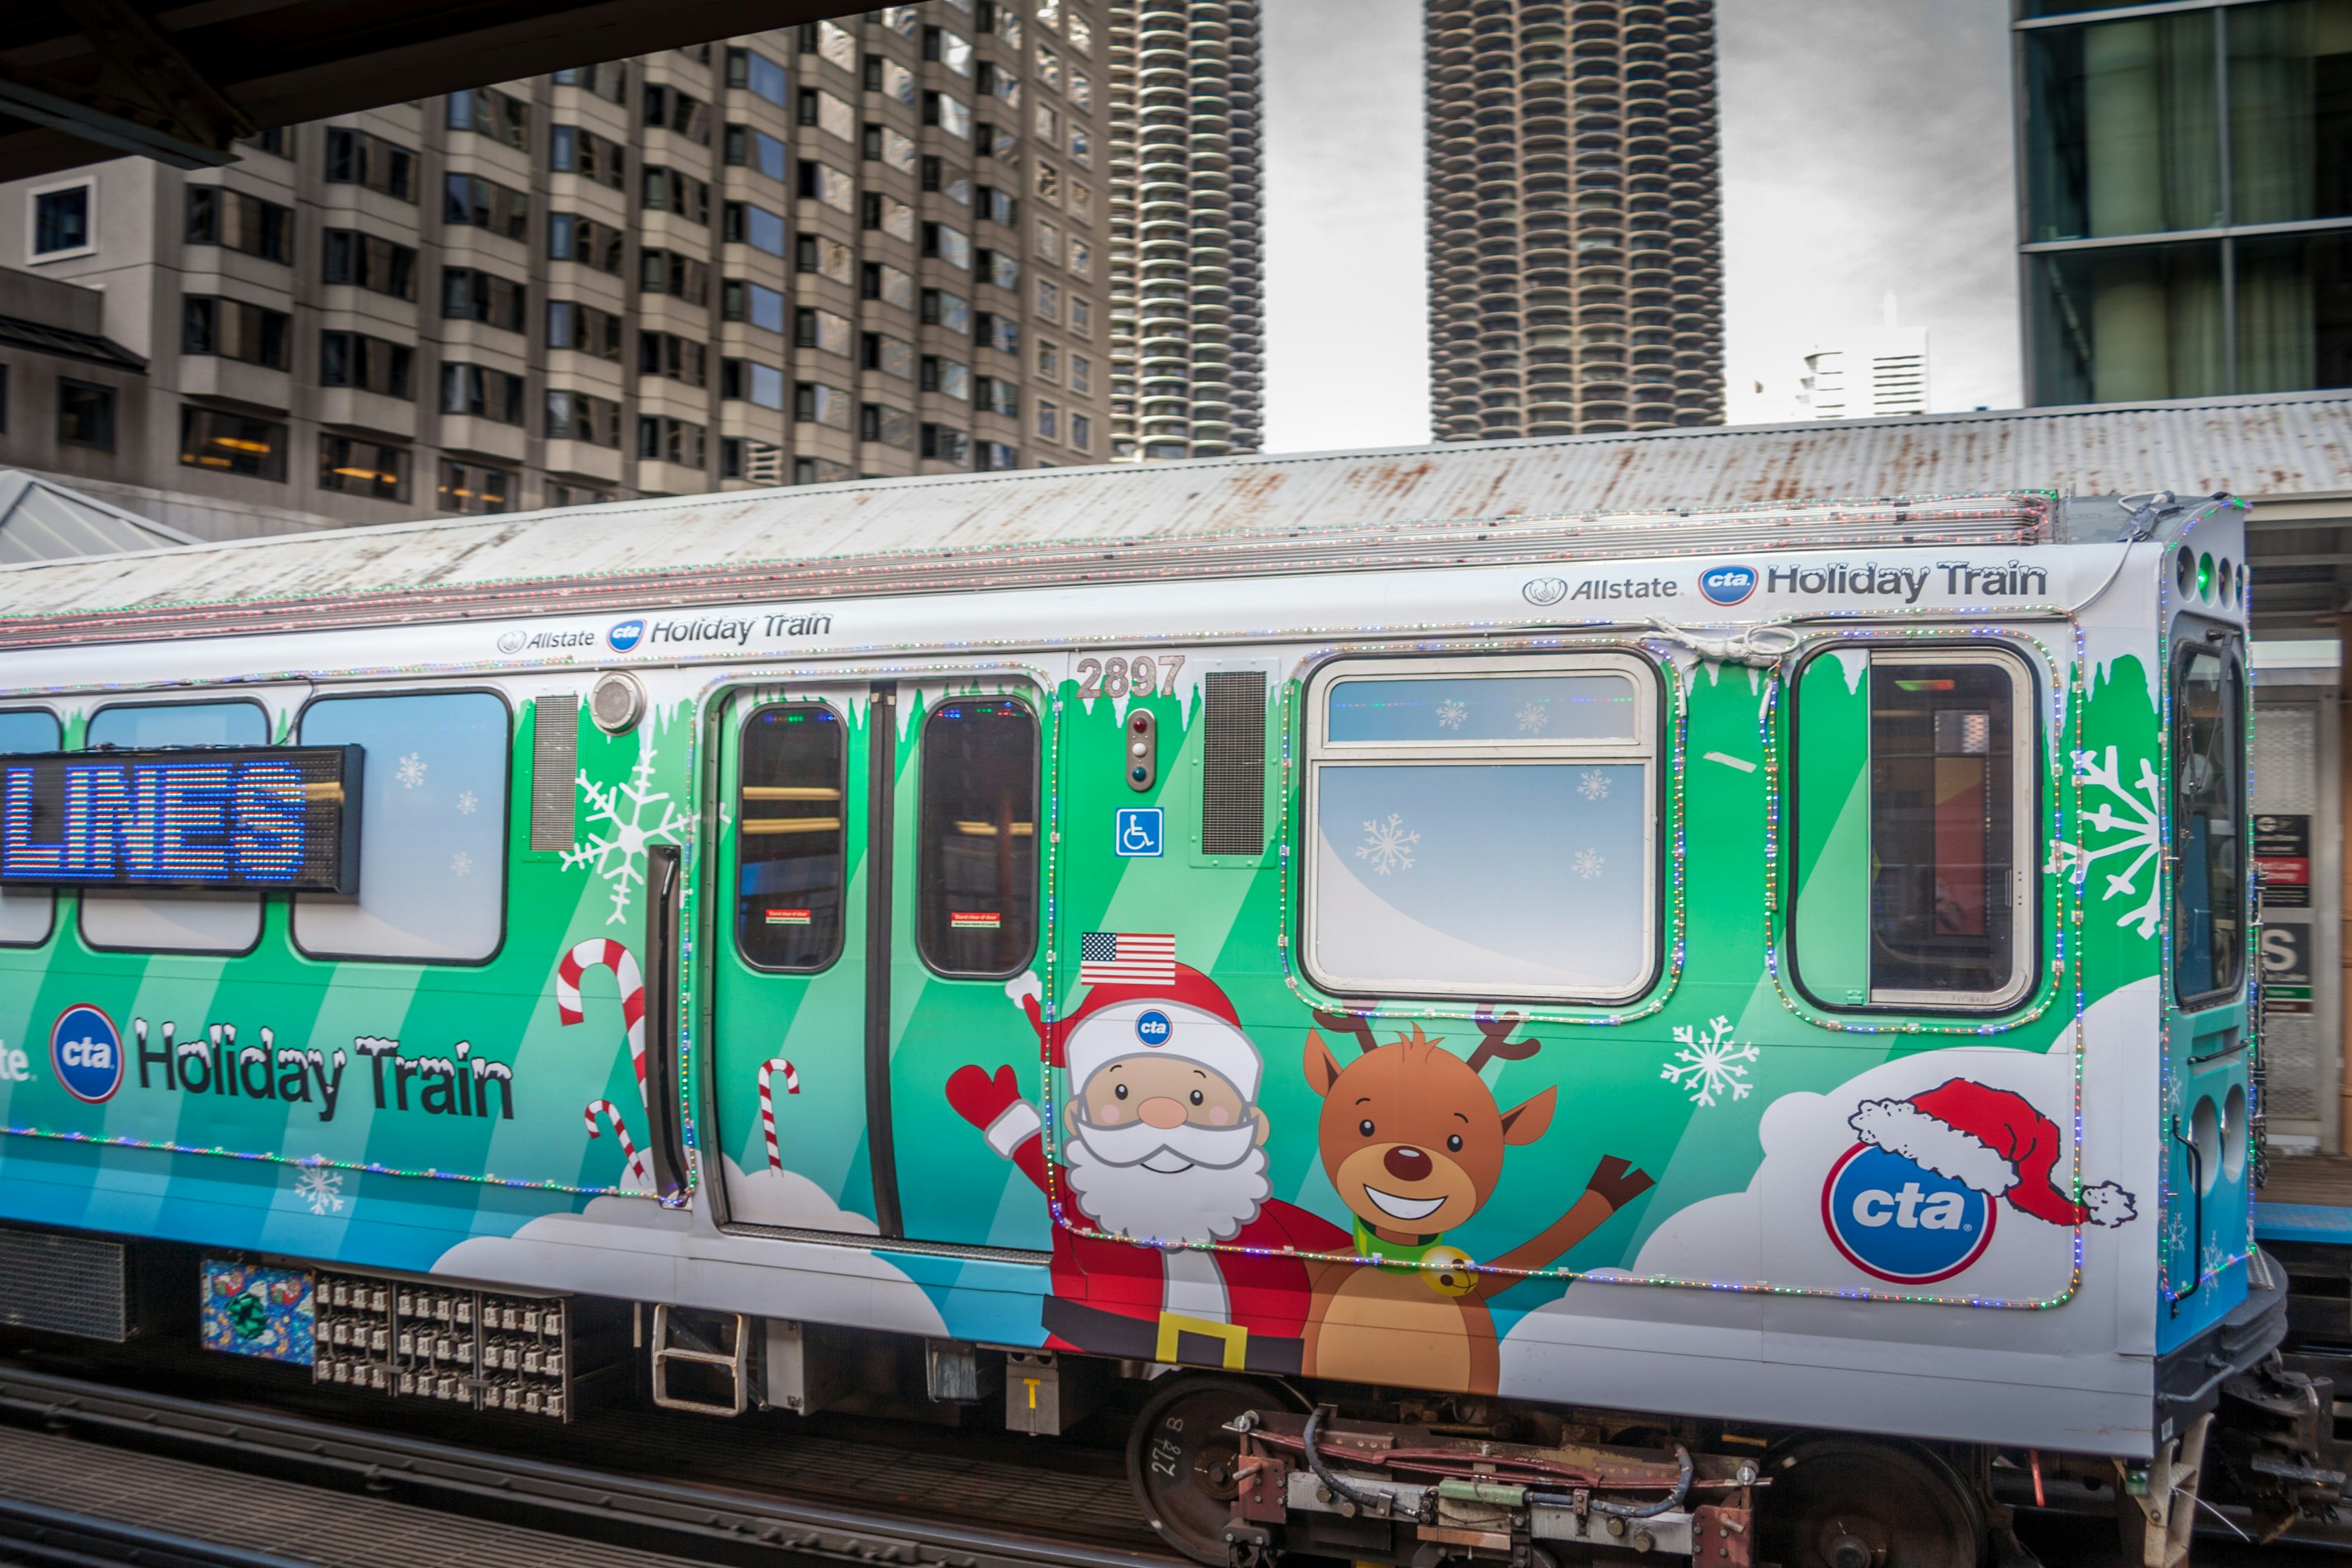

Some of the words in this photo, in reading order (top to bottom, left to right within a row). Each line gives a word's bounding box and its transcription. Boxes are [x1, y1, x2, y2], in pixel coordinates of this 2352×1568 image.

[1570, 579, 1678, 600] Allstate
[1767, 561, 1931, 604] Holiday
[1936, 560, 2047, 596] Train
[527, 631, 595, 649] Allstate
[650, 616, 759, 646] Holiday
[764, 610, 834, 637] Train
[1075, 654, 1186, 699] 2897
[2, 761, 306, 881] LINES
[1141, 1020, 1167, 1034] cta
[62, 1037, 112, 1069] cta
[134, 1018, 347, 1122] Holiday
[353, 1036, 515, 1120] Train
